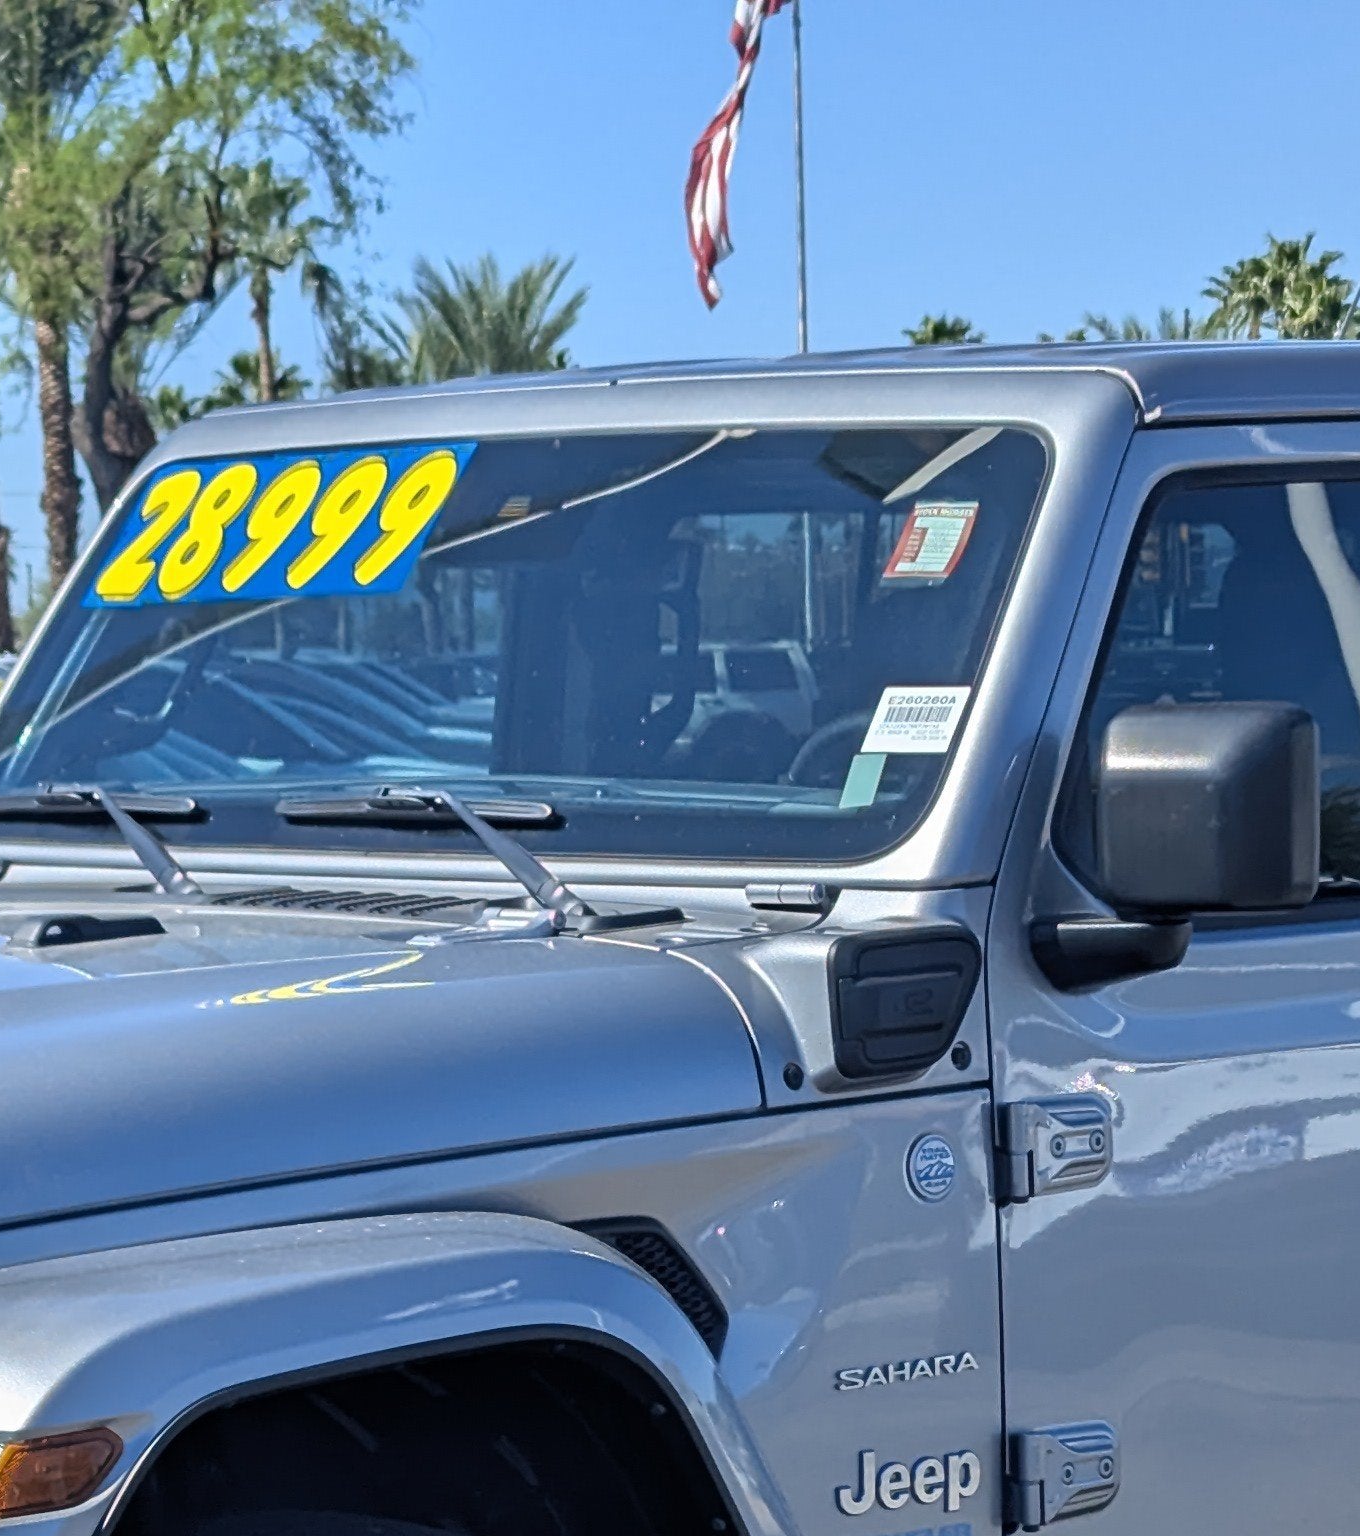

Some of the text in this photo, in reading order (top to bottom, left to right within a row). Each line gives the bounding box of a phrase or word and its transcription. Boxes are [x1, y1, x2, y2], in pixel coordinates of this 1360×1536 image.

[96, 449, 458, 602] 28999
[887, 695, 956, 705] E260260A
[837, 1352, 979, 1391] SAHARA
[836, 1449, 981, 1515] Jeep
